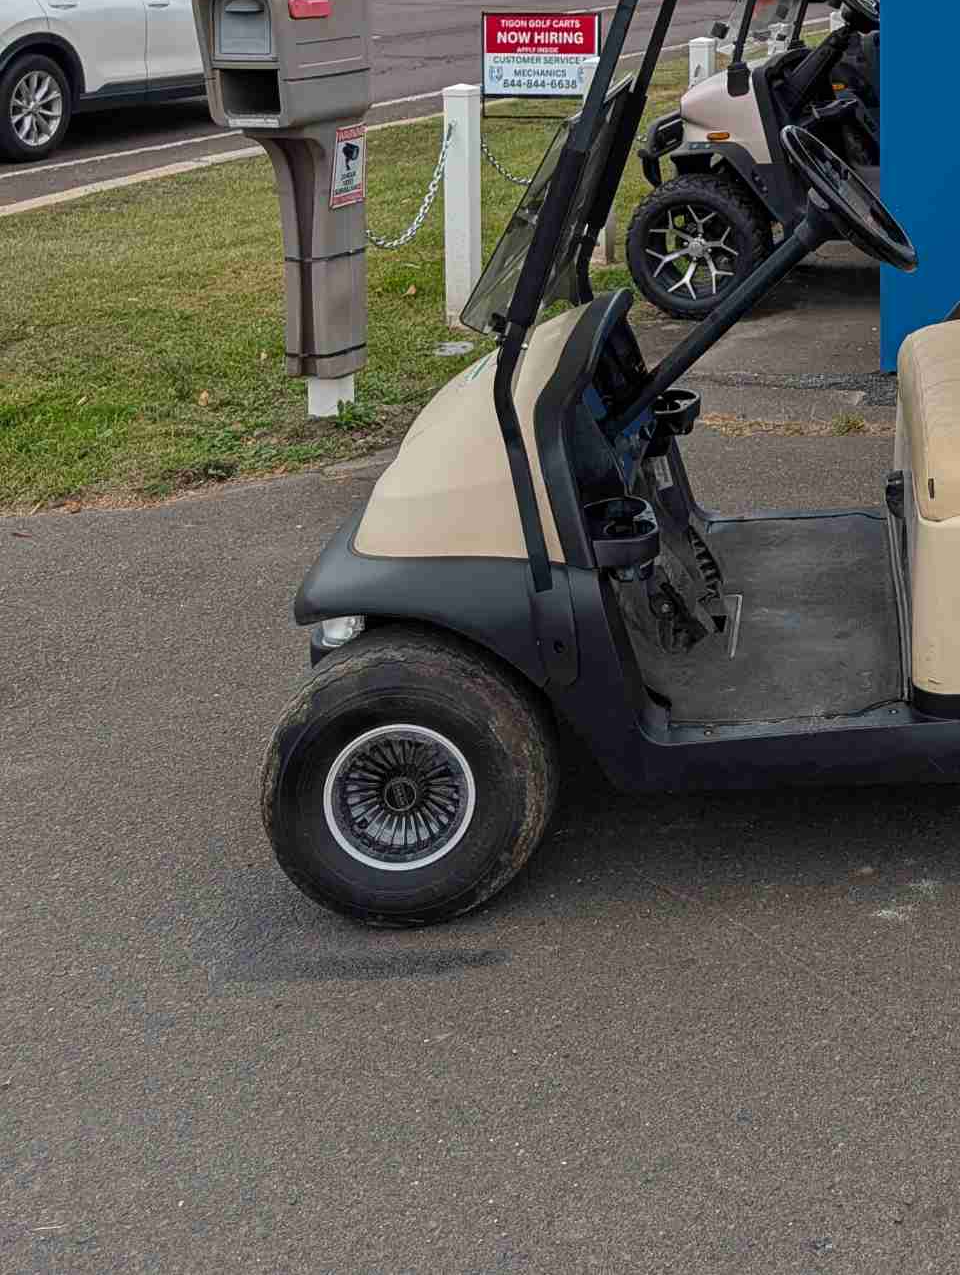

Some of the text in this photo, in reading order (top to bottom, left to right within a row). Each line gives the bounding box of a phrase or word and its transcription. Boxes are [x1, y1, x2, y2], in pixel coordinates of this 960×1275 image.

[528, 19, 551, 28] GOLF
[552, 19, 581, 28] CARTS
[496, 31, 584, 45] NOW HIRING
[543, 56, 581, 64] SERVICE
[513, 68, 567, 78] MECHANICS
